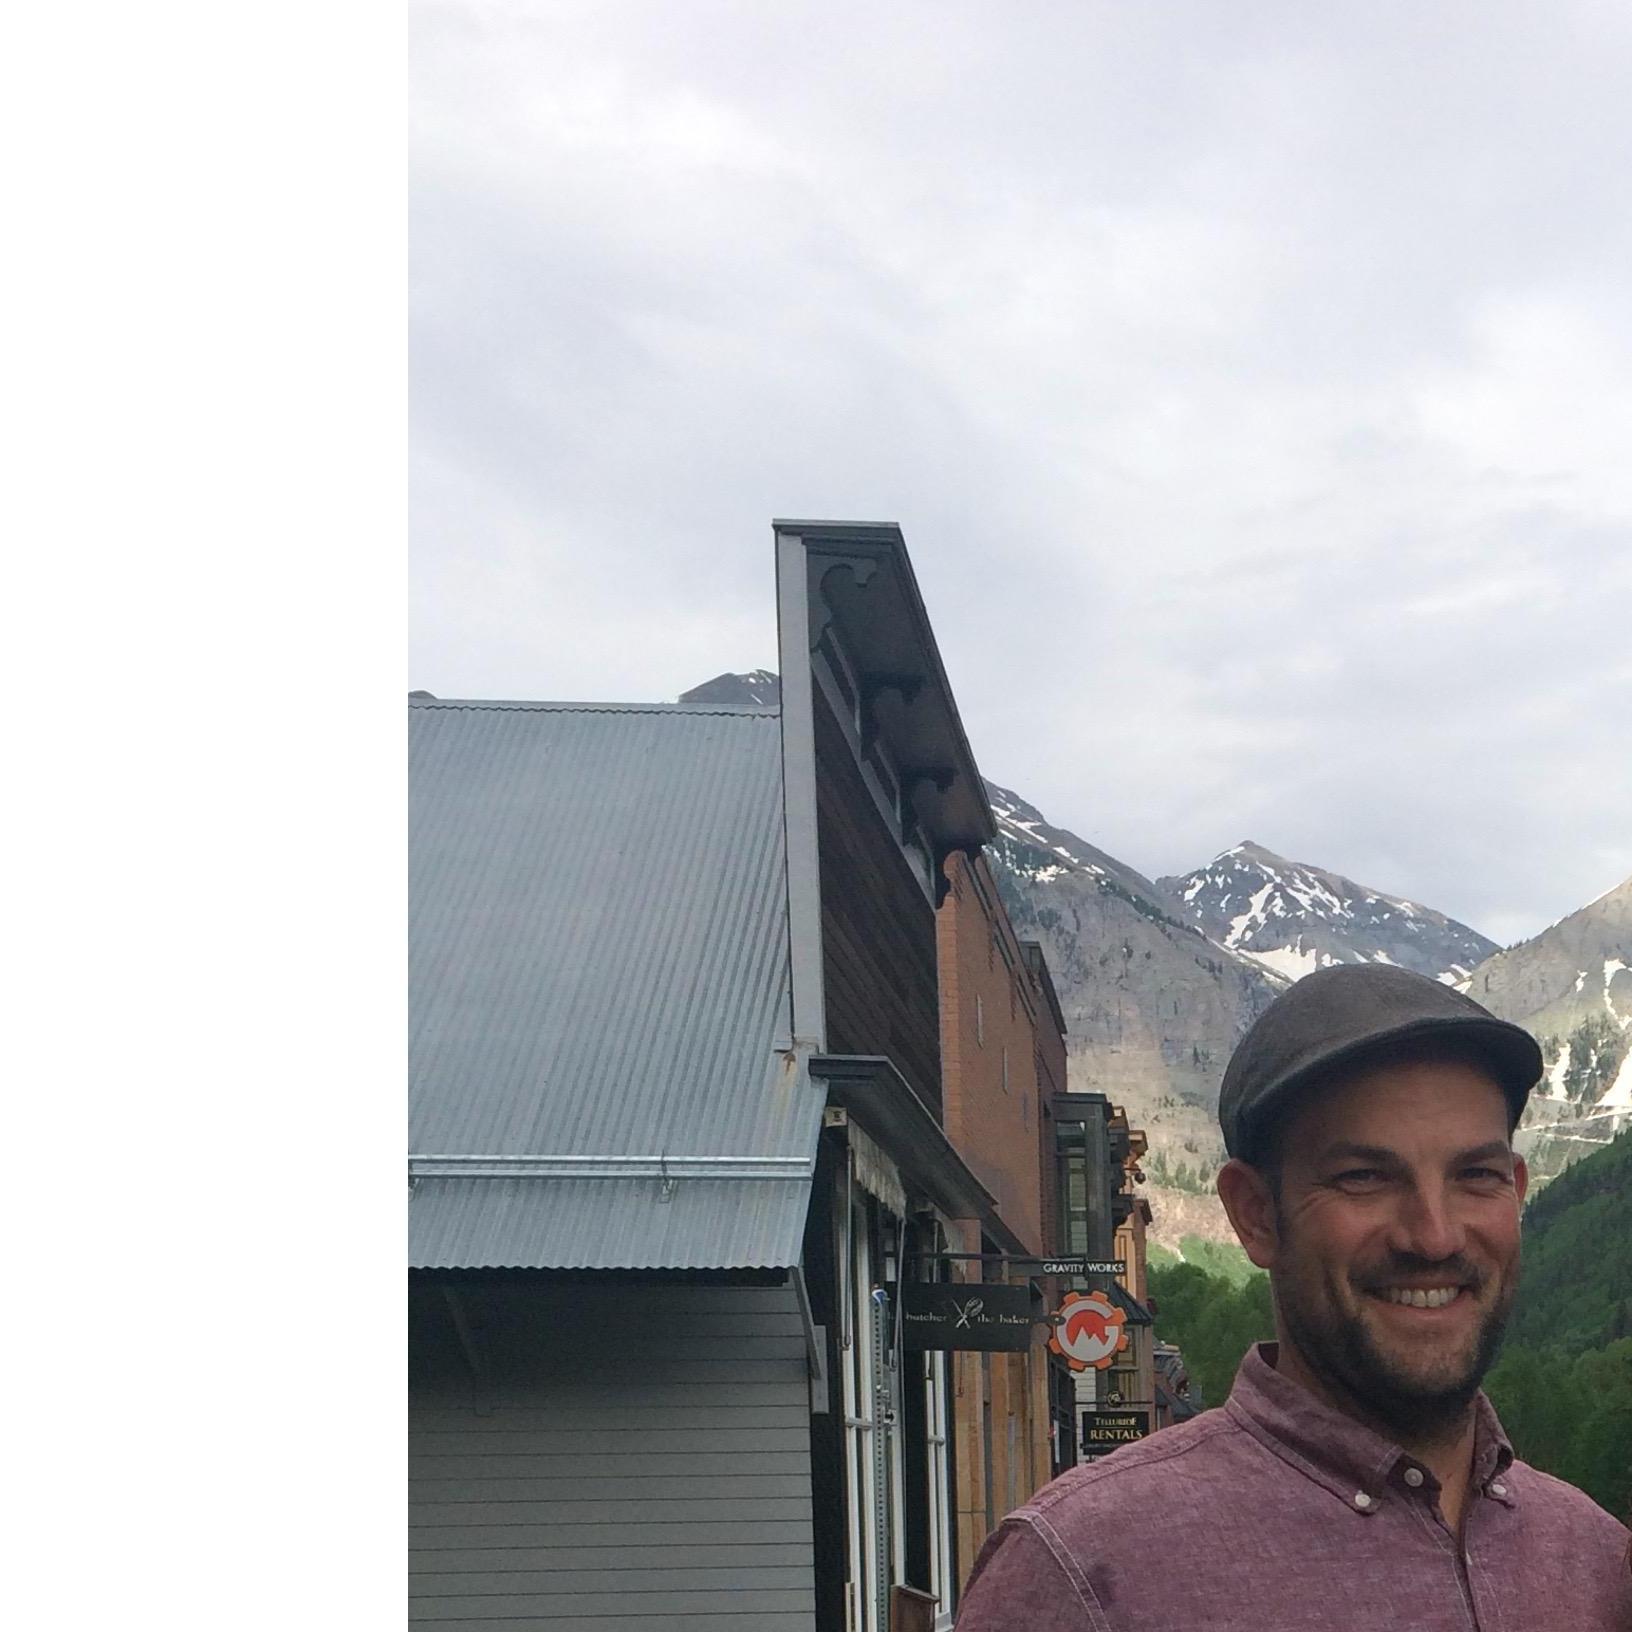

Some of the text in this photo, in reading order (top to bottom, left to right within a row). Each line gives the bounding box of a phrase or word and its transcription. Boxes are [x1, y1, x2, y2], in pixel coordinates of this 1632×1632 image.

[1043, 1263, 1125, 1273] GRAVITY WORKS
[999, 1314, 1030, 1324] baker
[1090, 1429, 1143, 1440] RENTALS
